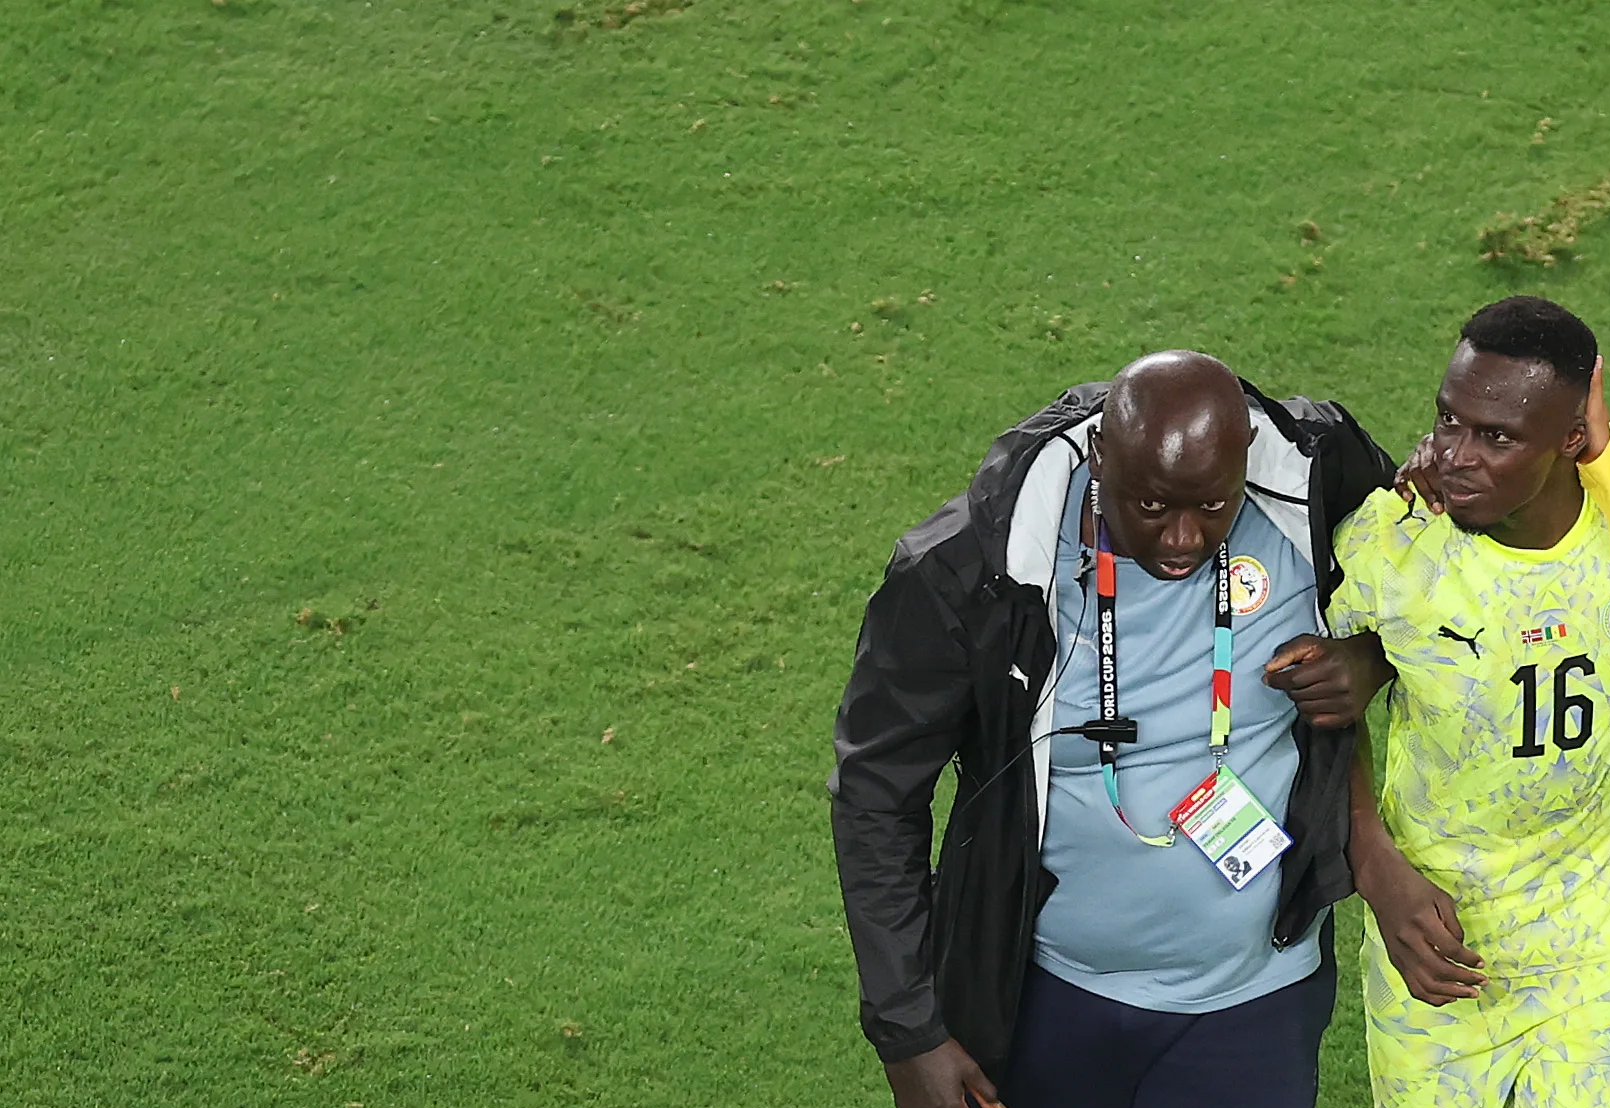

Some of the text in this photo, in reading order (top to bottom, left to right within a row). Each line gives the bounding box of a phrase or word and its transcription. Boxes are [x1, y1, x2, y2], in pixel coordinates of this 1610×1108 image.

[1218, 542, 1229, 613] CUP 2026
[1102, 611, 1115, 721] ORLD CUP 2026
[1509, 653, 1596, 758] 16
